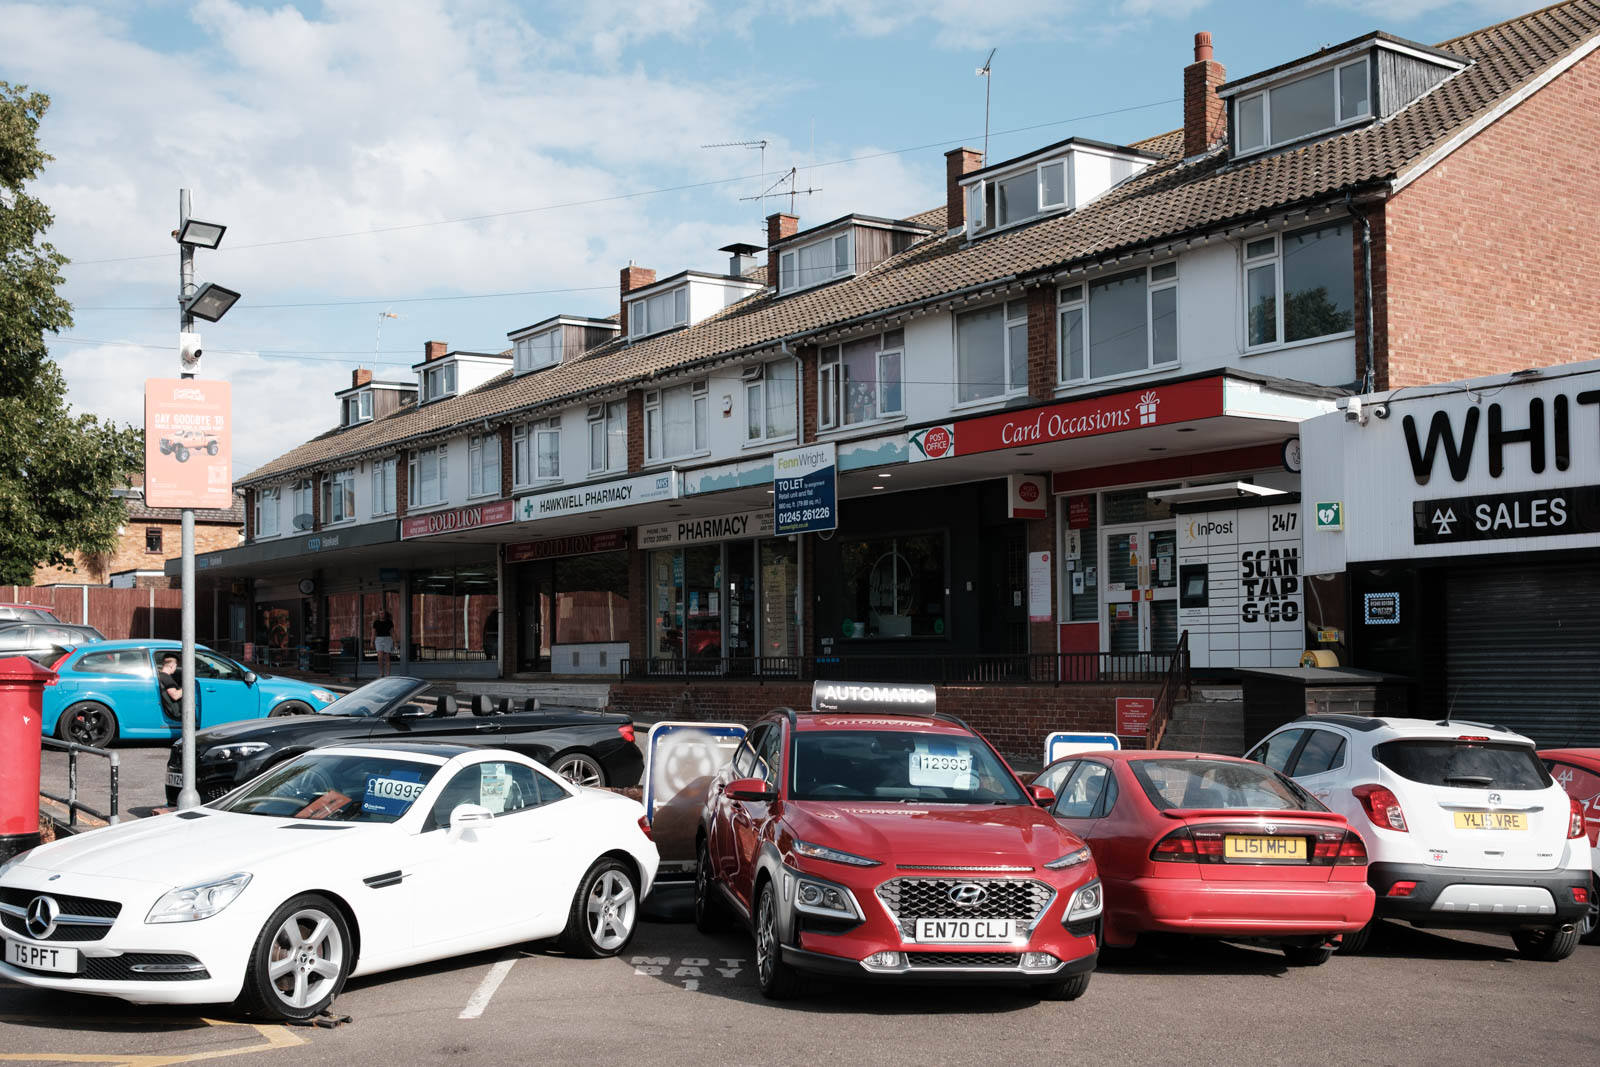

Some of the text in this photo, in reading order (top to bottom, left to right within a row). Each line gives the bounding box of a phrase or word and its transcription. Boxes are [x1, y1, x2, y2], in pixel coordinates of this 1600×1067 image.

[1002, 407, 1131, 444] Card Occasions
[926, 440, 947, 451] OFFICE
[929, 432, 945, 443] POST
[656, 478, 668, 489] NHS
[778, 480, 789, 491] TO
[789, 478, 804, 490] LET
[540, 494, 583, 512] HAWKWELL
[585, 485, 633, 506] PHARMACY
[428, 512, 456, 532] GOLD
[456, 507, 482, 527] LION
[778, 507, 830, 524] 01245 261226
[1272, 512, 1298, 532] 24/7
[1475, 498, 1567, 532] SALES
[678, 515, 749, 541] PHARMACY
[1197, 520, 1233, 536] InPost
[1242, 547, 1298, 578] SCAN
[1242, 577, 1298, 602] TAP
[1242, 601, 1298, 623] & GO
[824, 685, 929, 705] AUTOMATIC
[1463, 813, 1520, 828] YL15 VRE
[1234, 838, 1297, 854] L151 MHJ
[923, 921, 1009, 939] EN70 CLJ
[14, 943, 60, 968] T5 PFT
[630, 955, 747, 968] MOT
[633, 964, 744, 978] BAY
[680, 978, 700, 991] 1
